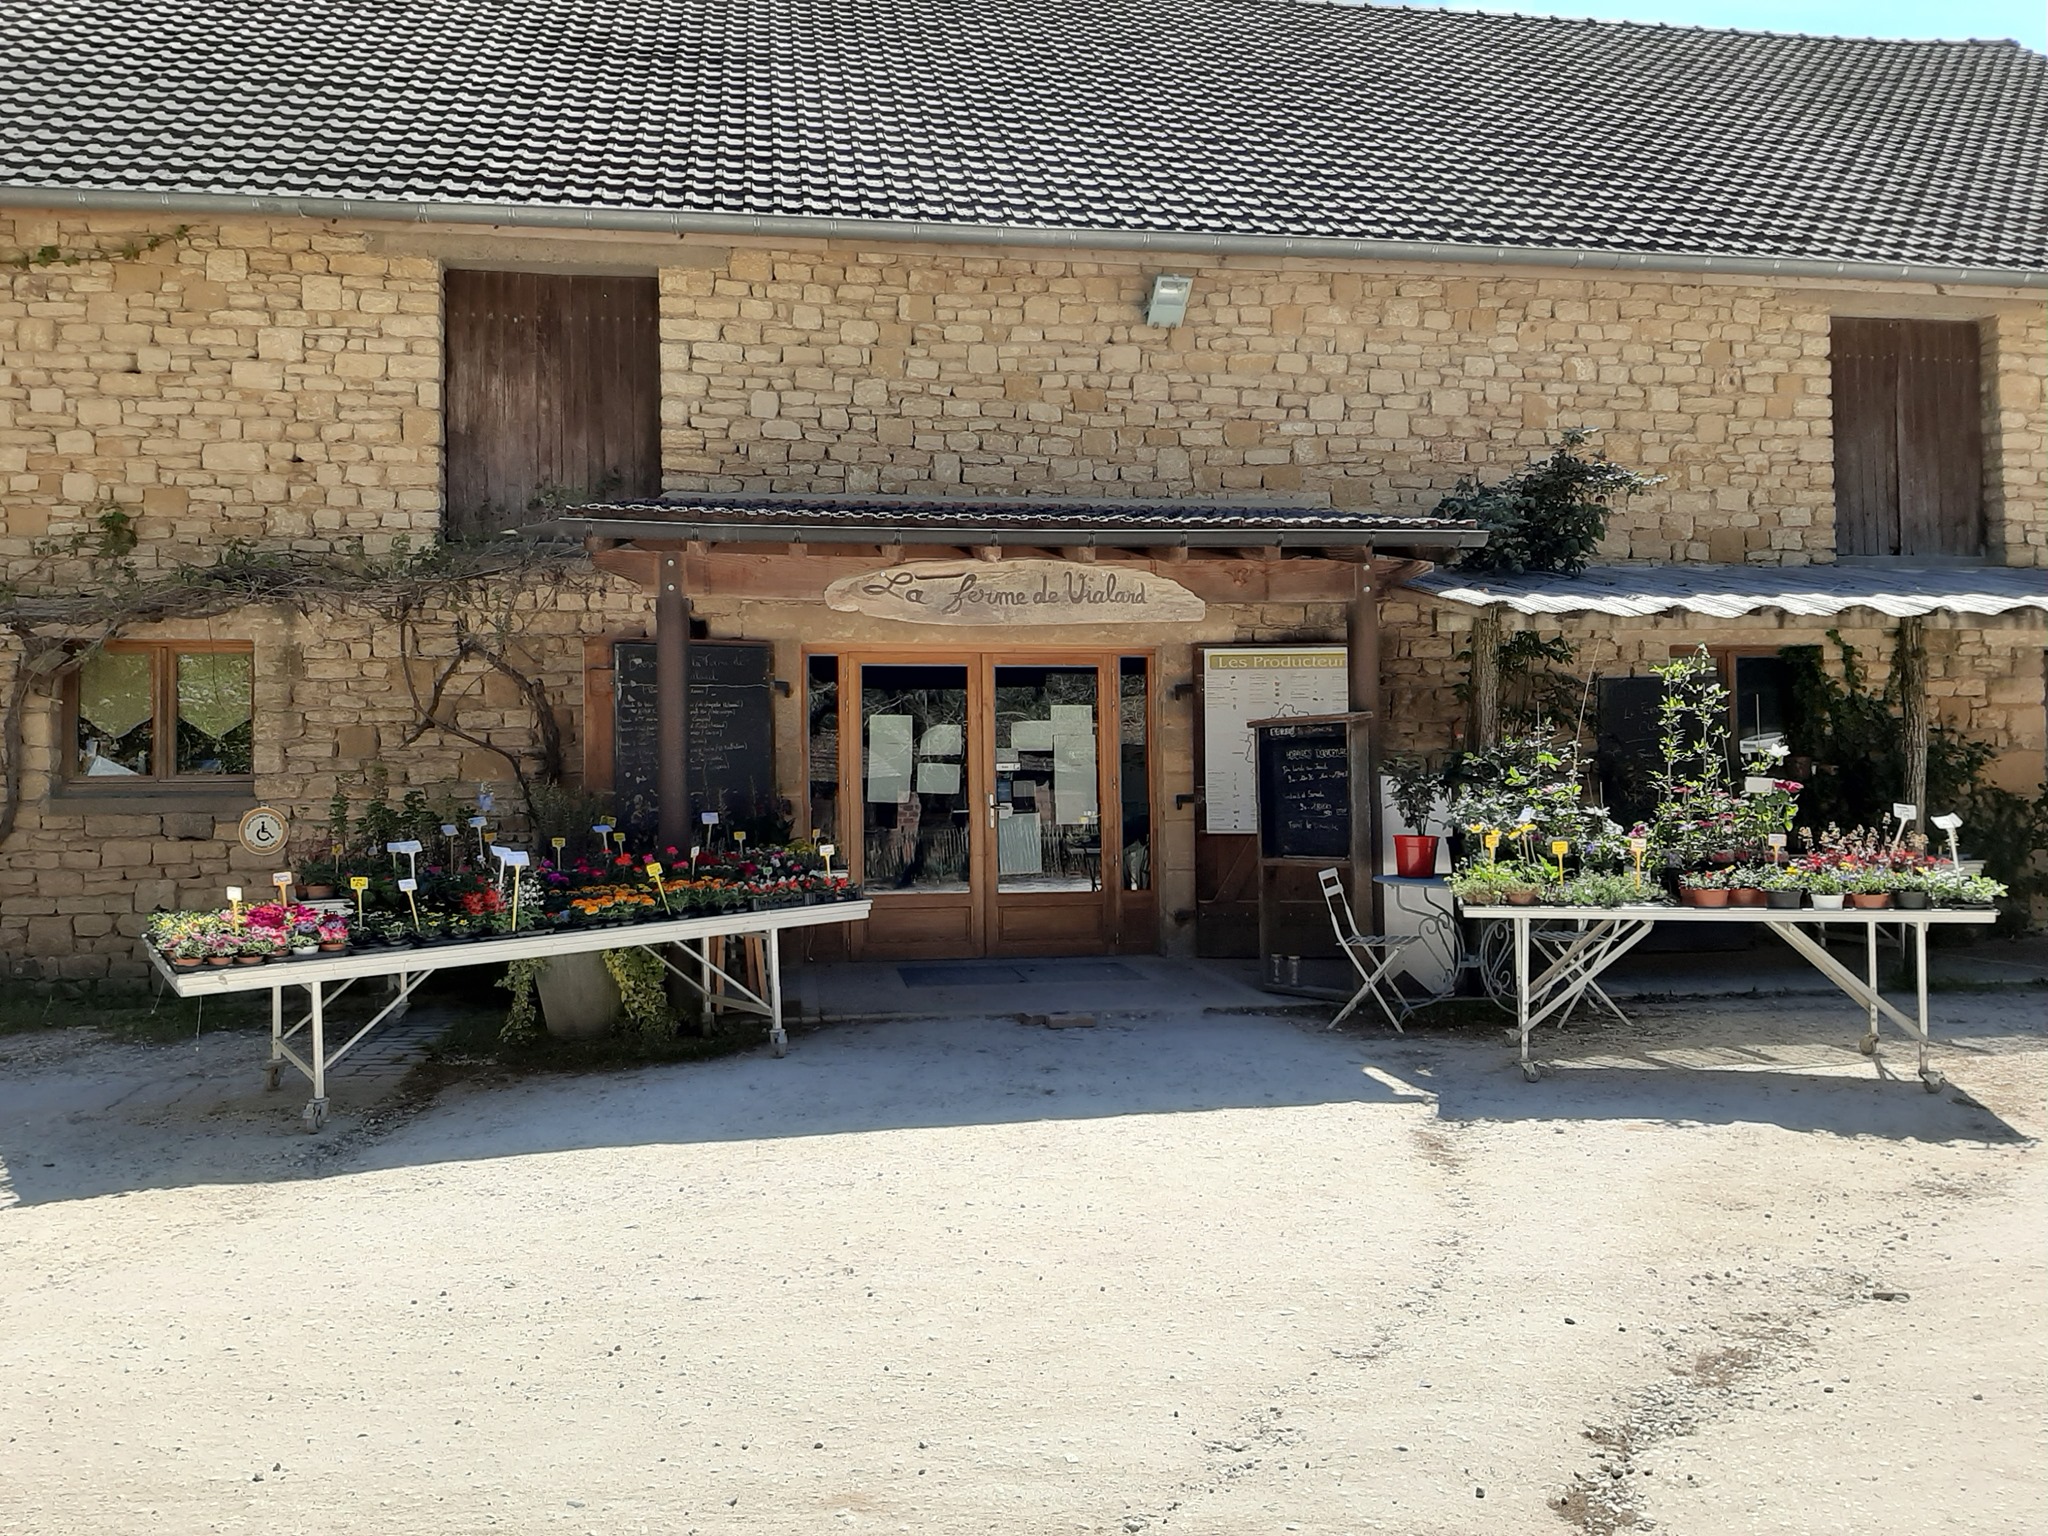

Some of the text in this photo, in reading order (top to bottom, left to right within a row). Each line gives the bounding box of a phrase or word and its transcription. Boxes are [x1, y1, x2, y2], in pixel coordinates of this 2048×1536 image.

[862, 571, 928, 605] La
[1032, 576, 1059, 604] de
[1064, 571, 1147, 605] Vialard
[1218, 656, 1248, 668] Les
